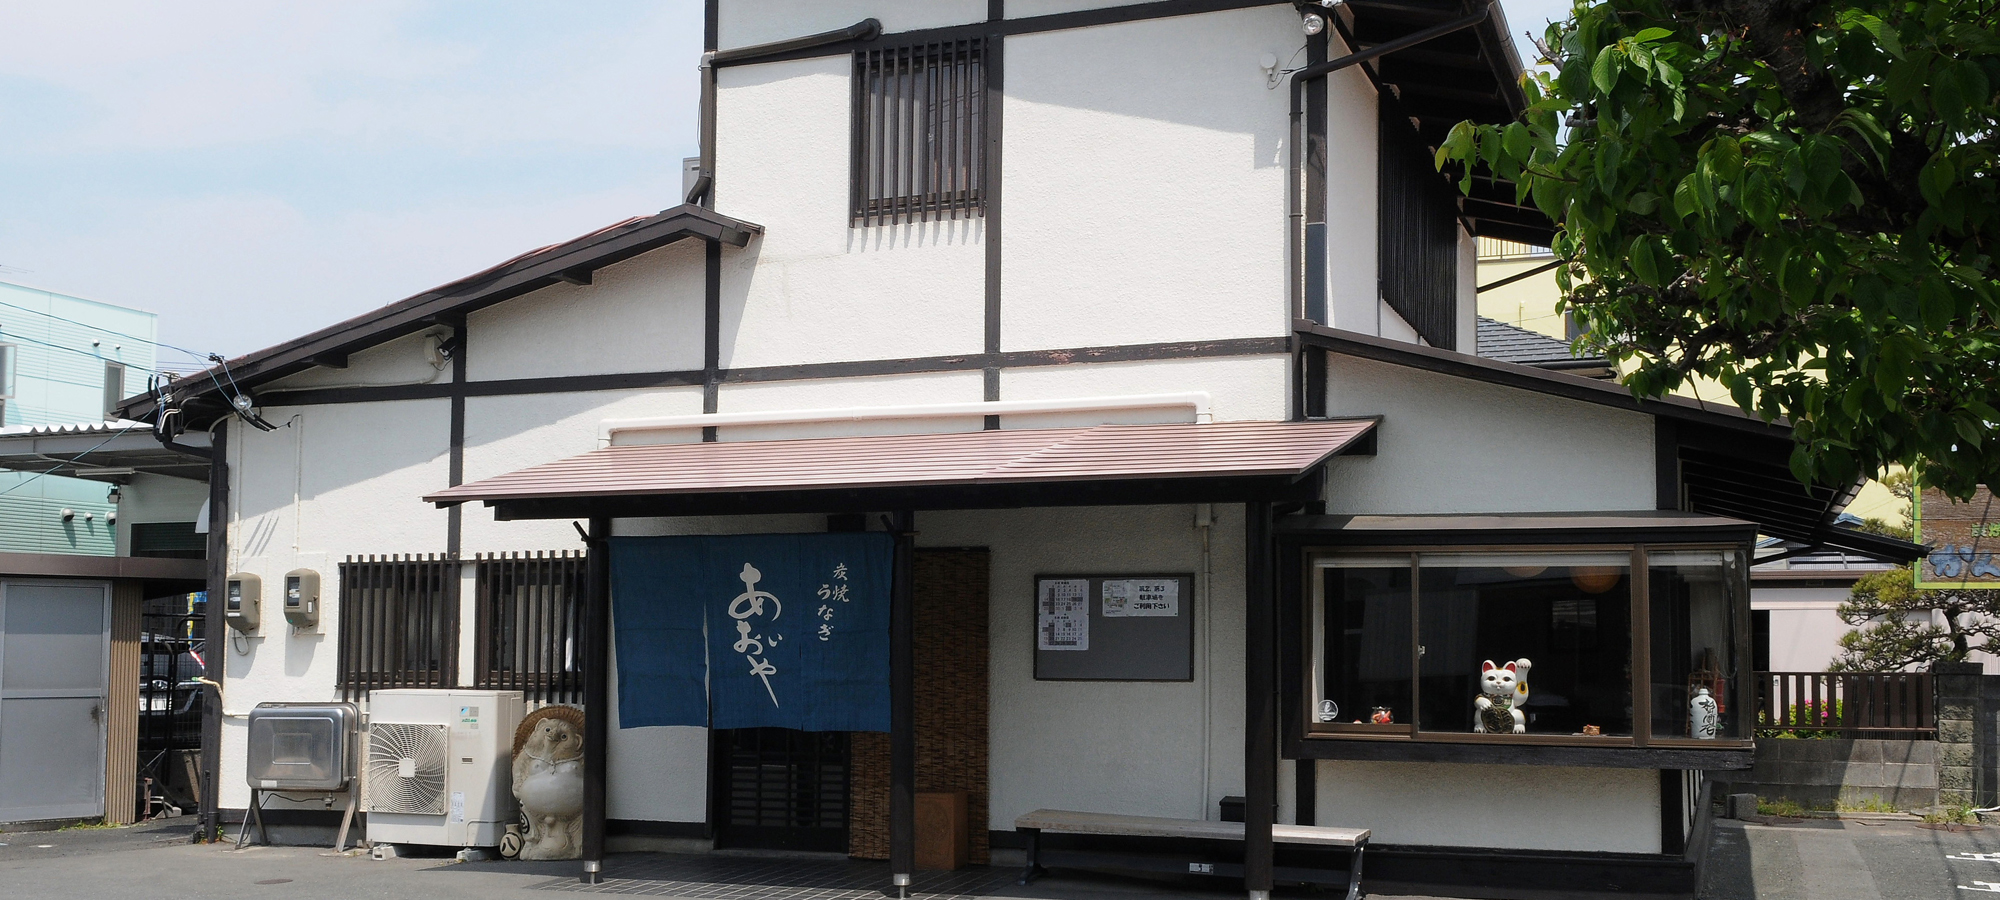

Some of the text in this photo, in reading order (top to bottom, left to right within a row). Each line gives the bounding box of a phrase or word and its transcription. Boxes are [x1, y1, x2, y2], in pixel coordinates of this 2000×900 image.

[832, 562, 850, 603] 炭焼
[816, 583, 835, 642] うなぎ
[501, 836, 517, 852] 八
